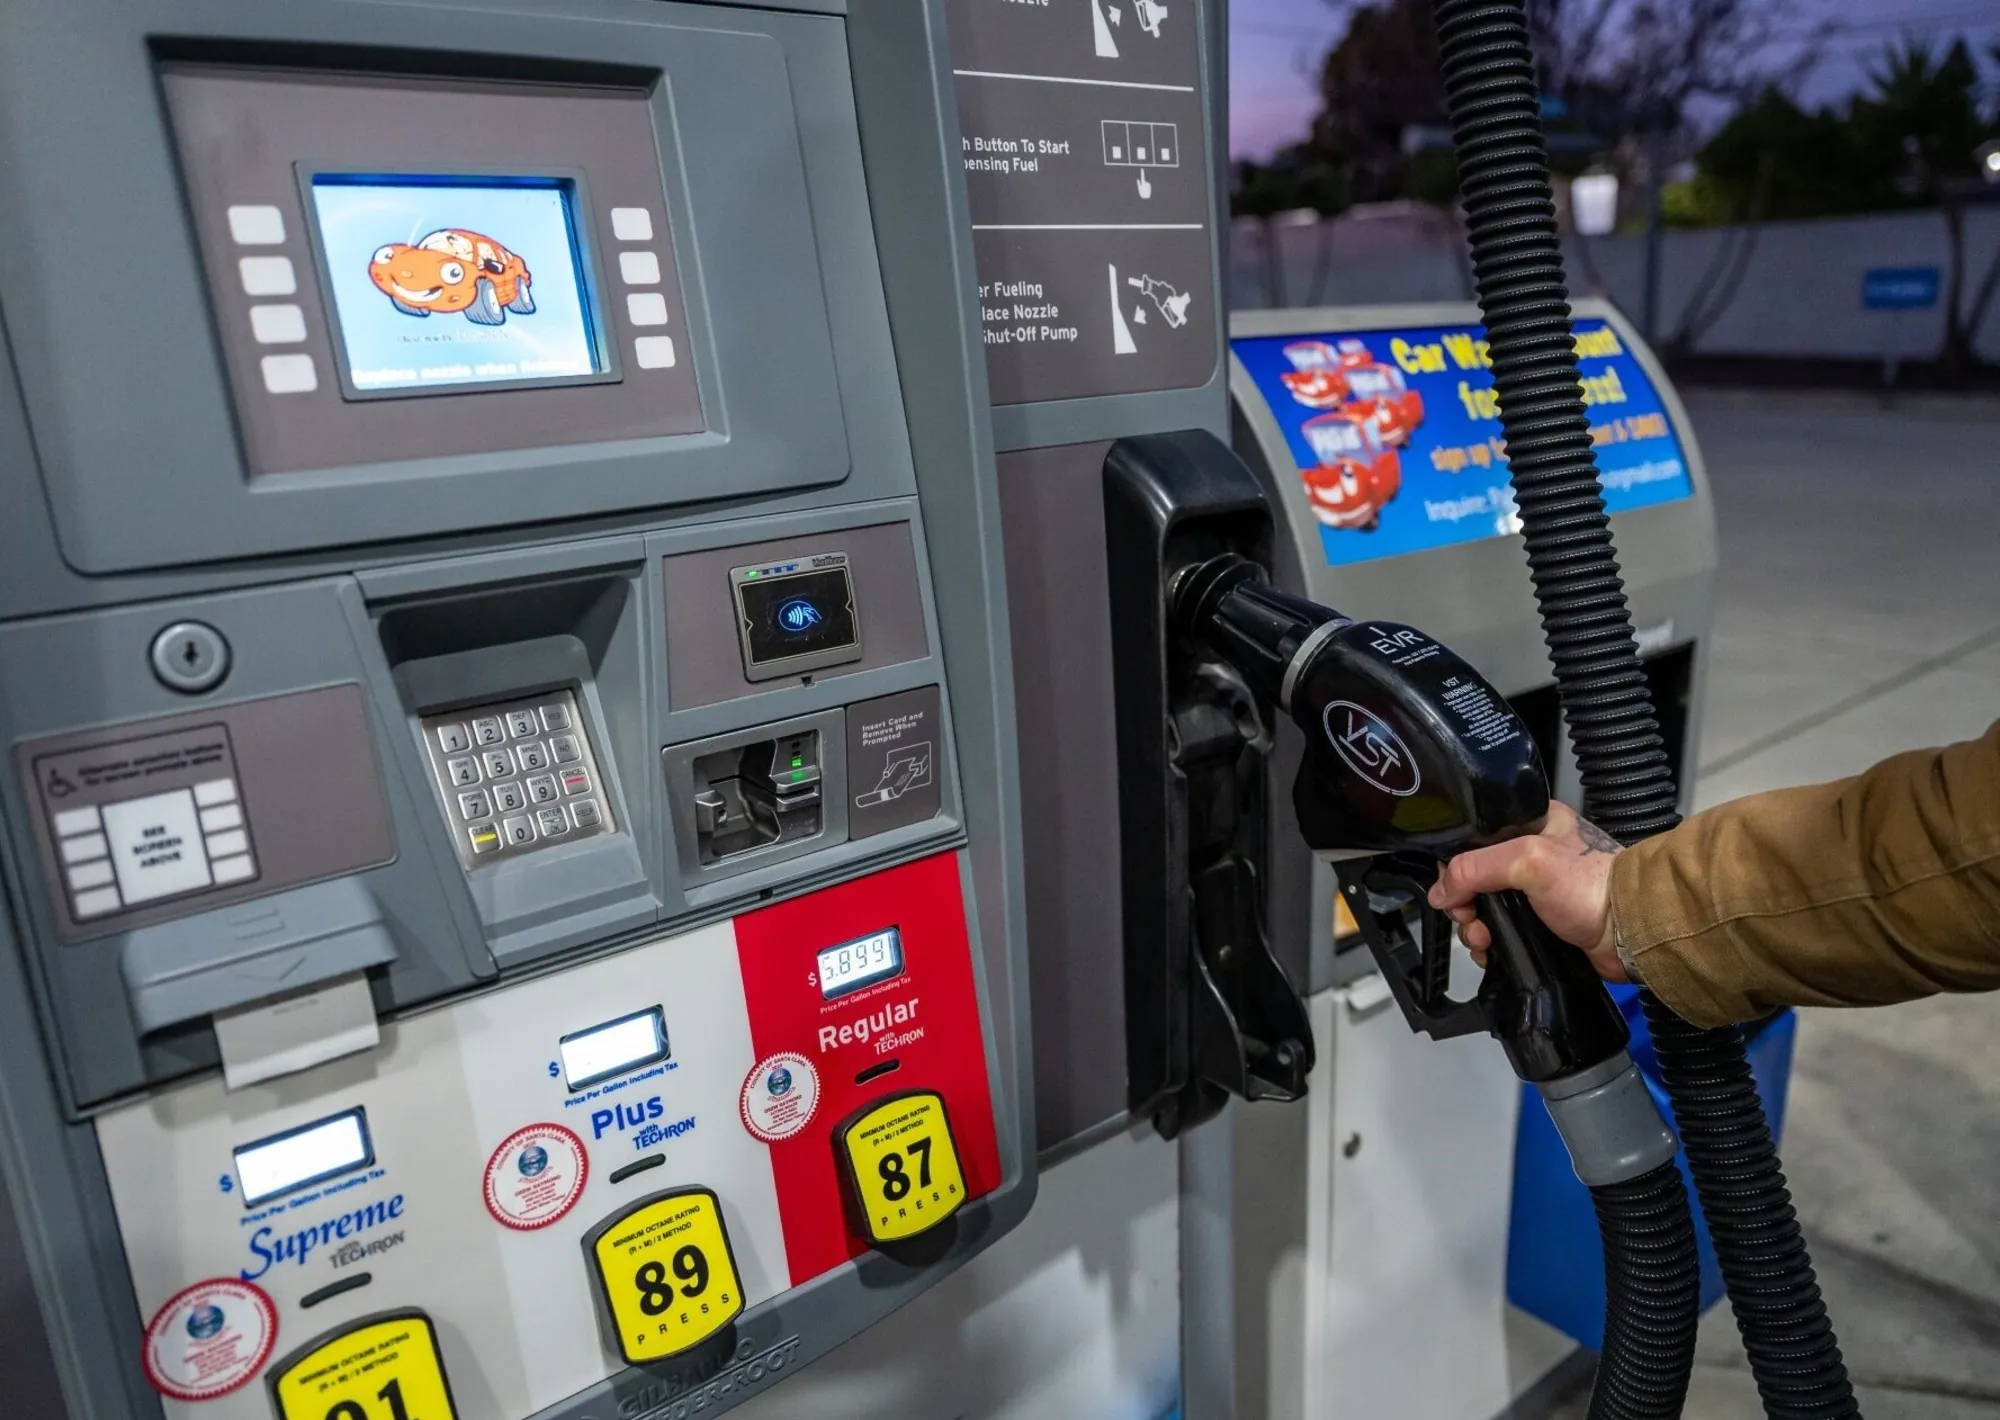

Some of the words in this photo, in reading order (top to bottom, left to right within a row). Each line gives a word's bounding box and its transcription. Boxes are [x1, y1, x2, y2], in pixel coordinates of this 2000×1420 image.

[974, 137, 1018, 152] Button
[1020, 139, 1035, 152] To
[1039, 140, 1070, 154] Start
[1013, 157, 1038, 172] Fuel
[994, 281, 1042, 299] Fueling
[1014, 303, 1059, 319] Nozzle
[1041, 326, 1078, 342] Pump
[1390, 337, 1447, 374] Car
[1370, 630, 1424, 655] EVR
[1441, 682, 1478, 700] WARNING
[1442, 676, 1460, 688] VST
[518, 722, 527, 733] 3
[862, 721, 886, 732] Insert
[888, 715, 907, 726] Card
[909, 711, 924, 720] and
[862, 727, 893, 739] Remove
[895, 721, 917, 731] When
[451, 736, 457, 747] 1
[484, 729, 494, 741] 2
[862, 731, 901, 747] Prompted
[495, 761, 504, 773] 5
[529, 753, 538, 766] 6
[461, 769, 469, 780] 4
[561, 767, 586, 778] CANCEL
[505, 794, 514, 806] 8
[539, 787, 548, 798] 9
[470, 802, 478, 815] 7
[540, 806, 561, 820] ENTER
[516, 828, 525, 840] 0
[550, 825, 559, 833] OK
[808, 972, 817, 987] $
[819, 1002, 840, 1015] Price
[837, 999, 849, 1008] Per
[850, 990, 871, 1003] Gallon
[871, 981, 900, 996] Including
[899, 977, 911, 985] Tax
[818, 997, 920, 1053] Regular
[874, 1026, 925, 1055] TECHRON
[879, 1032, 896, 1042] with
[548, 1061, 559, 1078] $
[564, 1095, 586, 1108] Price
[586, 1090, 600, 1100] Per
[602, 1080, 628, 1094] Gallon
[629, 1066, 664, 1084] Including
[664, 1062, 678, 1072] Tax
[591, 1096, 664, 1140] Plus
[860, 1123, 886, 1140] MINIMUM
[886, 1113, 910, 1128] OCTANE
[909, 1104, 931, 1119] RATING
[900, 1119, 924, 1134] METHOD
[632, 1116, 695, 1150] TECHRON
[639, 1123, 659, 1136] with
[878, 1136, 932, 1202] 87
[219, 1174, 233, 1193] $
[240, 1211, 267, 1226] Price
[268, 1204, 286, 1216] Per
[288, 1192, 321, 1209] Gallon
[323, 1174, 367, 1196] Including
[368, 1168, 386, 1181] Tax
[881, 1184, 957, 1227] PRESS
[612, 1229, 645, 1248] MINIMUM
[645, 1215, 674, 1234] OCTANE
[674, 1205, 701, 1221] RATING
[240, 1193, 405, 1281] Supreme
[628, 1245, 637, 1256] (R
[643, 1239, 653, 1248] M)
[662, 1221, 692, 1239] METHOD
[329, 1230, 405, 1269] TECHRON
[635, 1244, 710, 1316] 89
[637, 1293, 730, 1345] PRESS
[340, 1347, 376, 1366] OCTANE
[378, 1332, 410, 1350] RATING
[361, 1352, 399, 1373] METHOD
